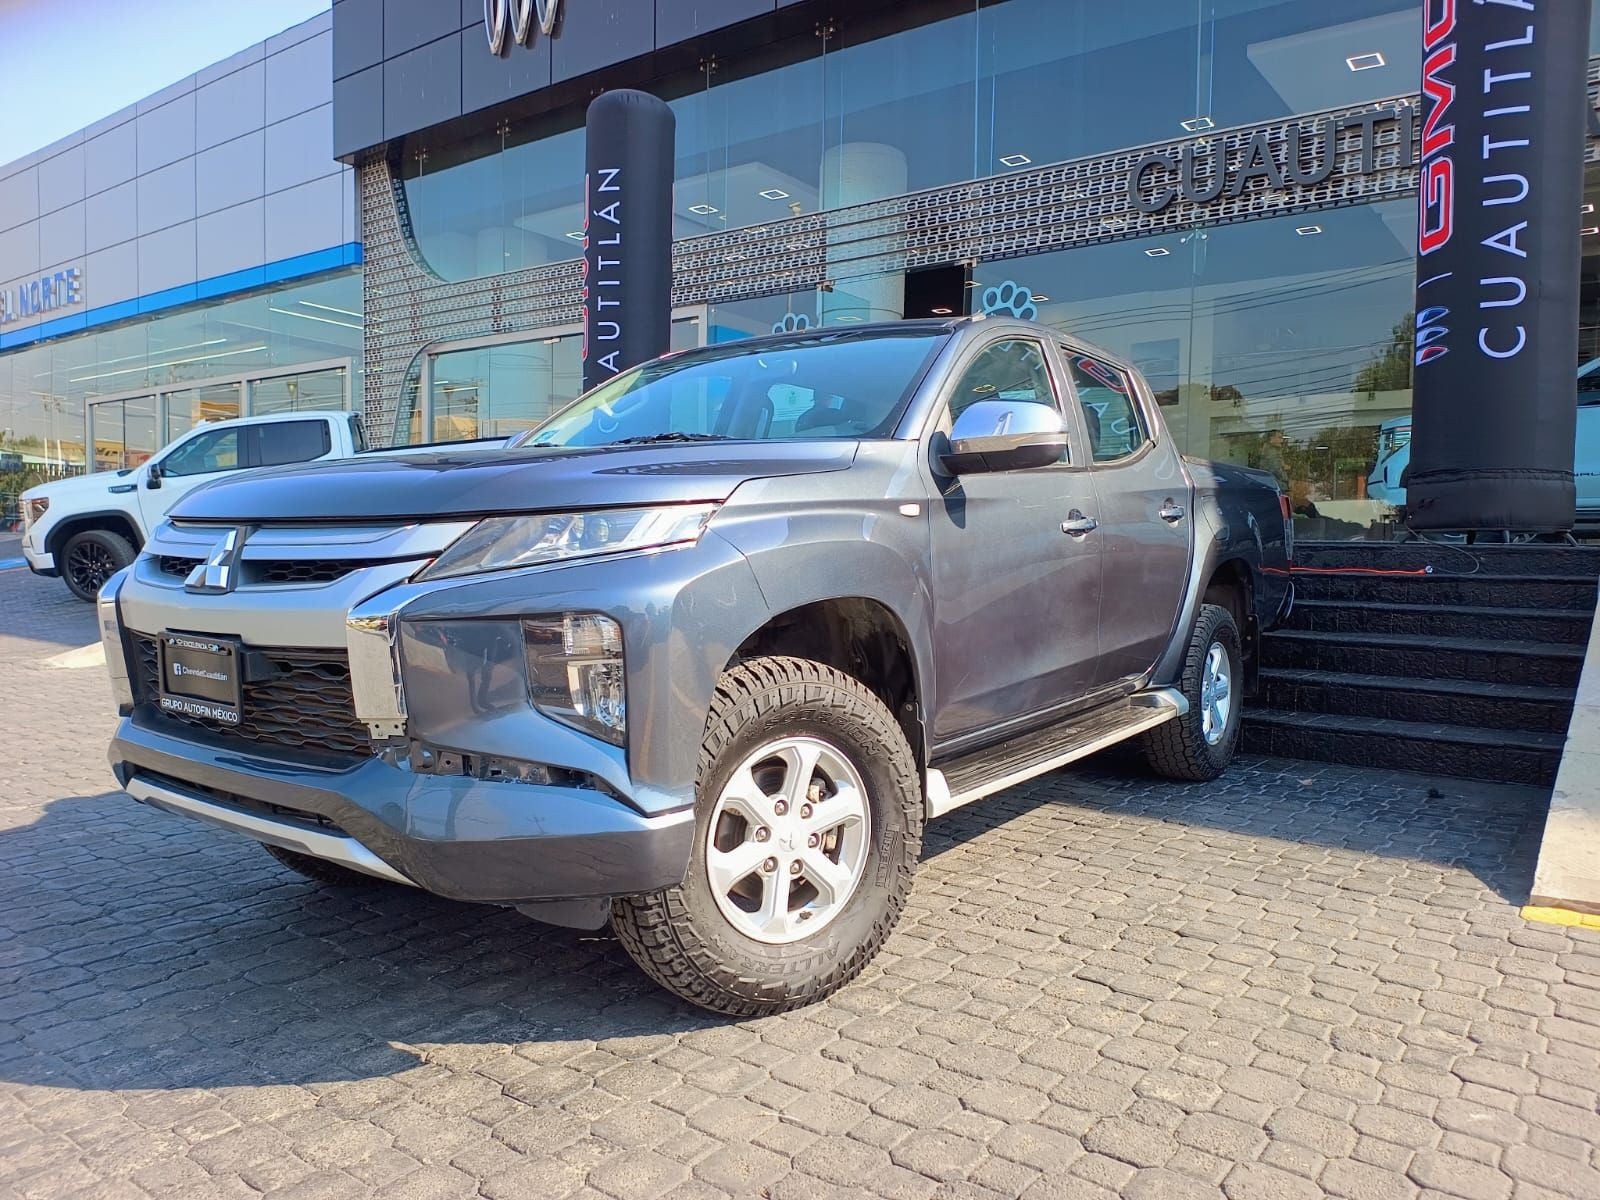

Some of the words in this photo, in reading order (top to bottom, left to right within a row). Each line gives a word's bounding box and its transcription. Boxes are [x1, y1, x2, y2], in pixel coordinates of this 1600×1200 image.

[1128, 105, 1413, 214] CUAUTI
[1478, 0, 1535, 359] CUAUTITL
[19, 266, 81, 317] NORTE
[161, 697, 183, 711] GRUPO
[183, 703, 211, 716] AUTOFIN
[212, 706, 238, 722] MÉXICO
